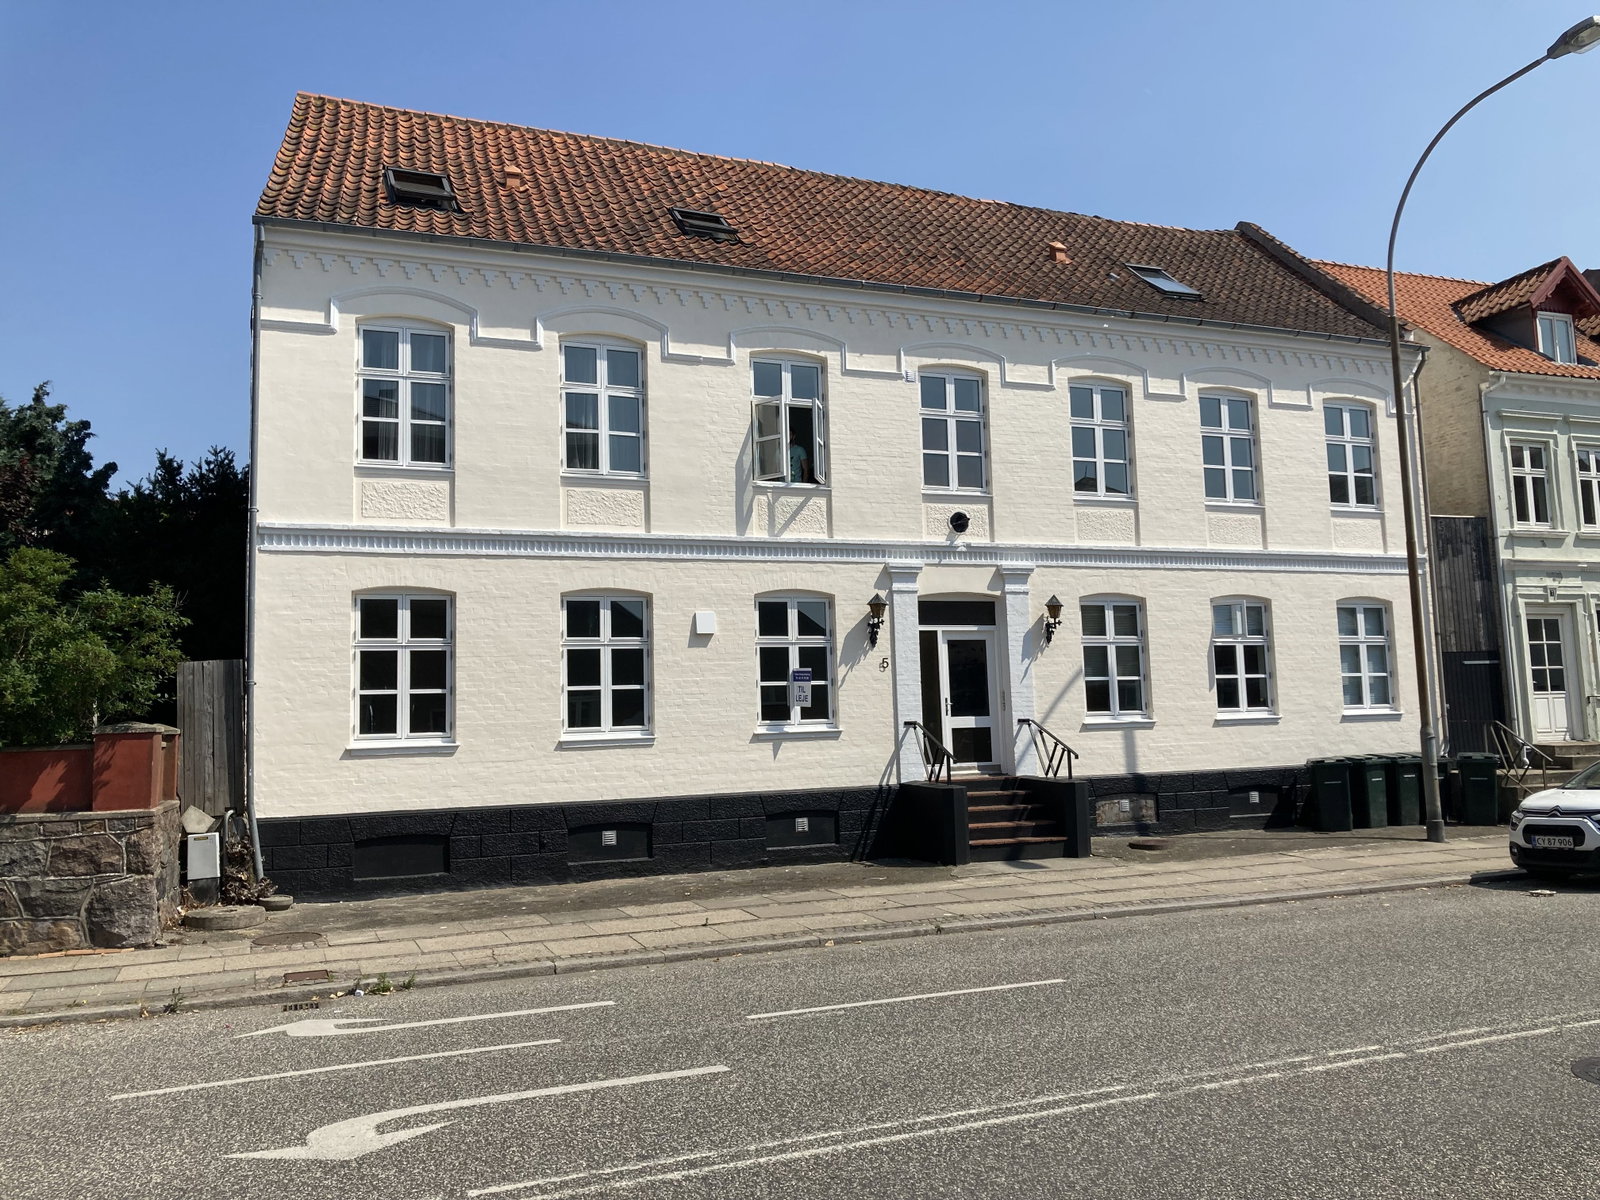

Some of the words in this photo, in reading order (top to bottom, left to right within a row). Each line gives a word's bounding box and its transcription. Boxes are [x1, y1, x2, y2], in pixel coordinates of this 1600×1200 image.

[882, 657, 889, 669] 5
[797, 685, 806, 693] TIL
[796, 694, 808, 702] LEJE
[1536, 837, 1546, 845] CY
[1547, 837, 1556, 846] 87
[1557, 838, 1573, 847] 906
